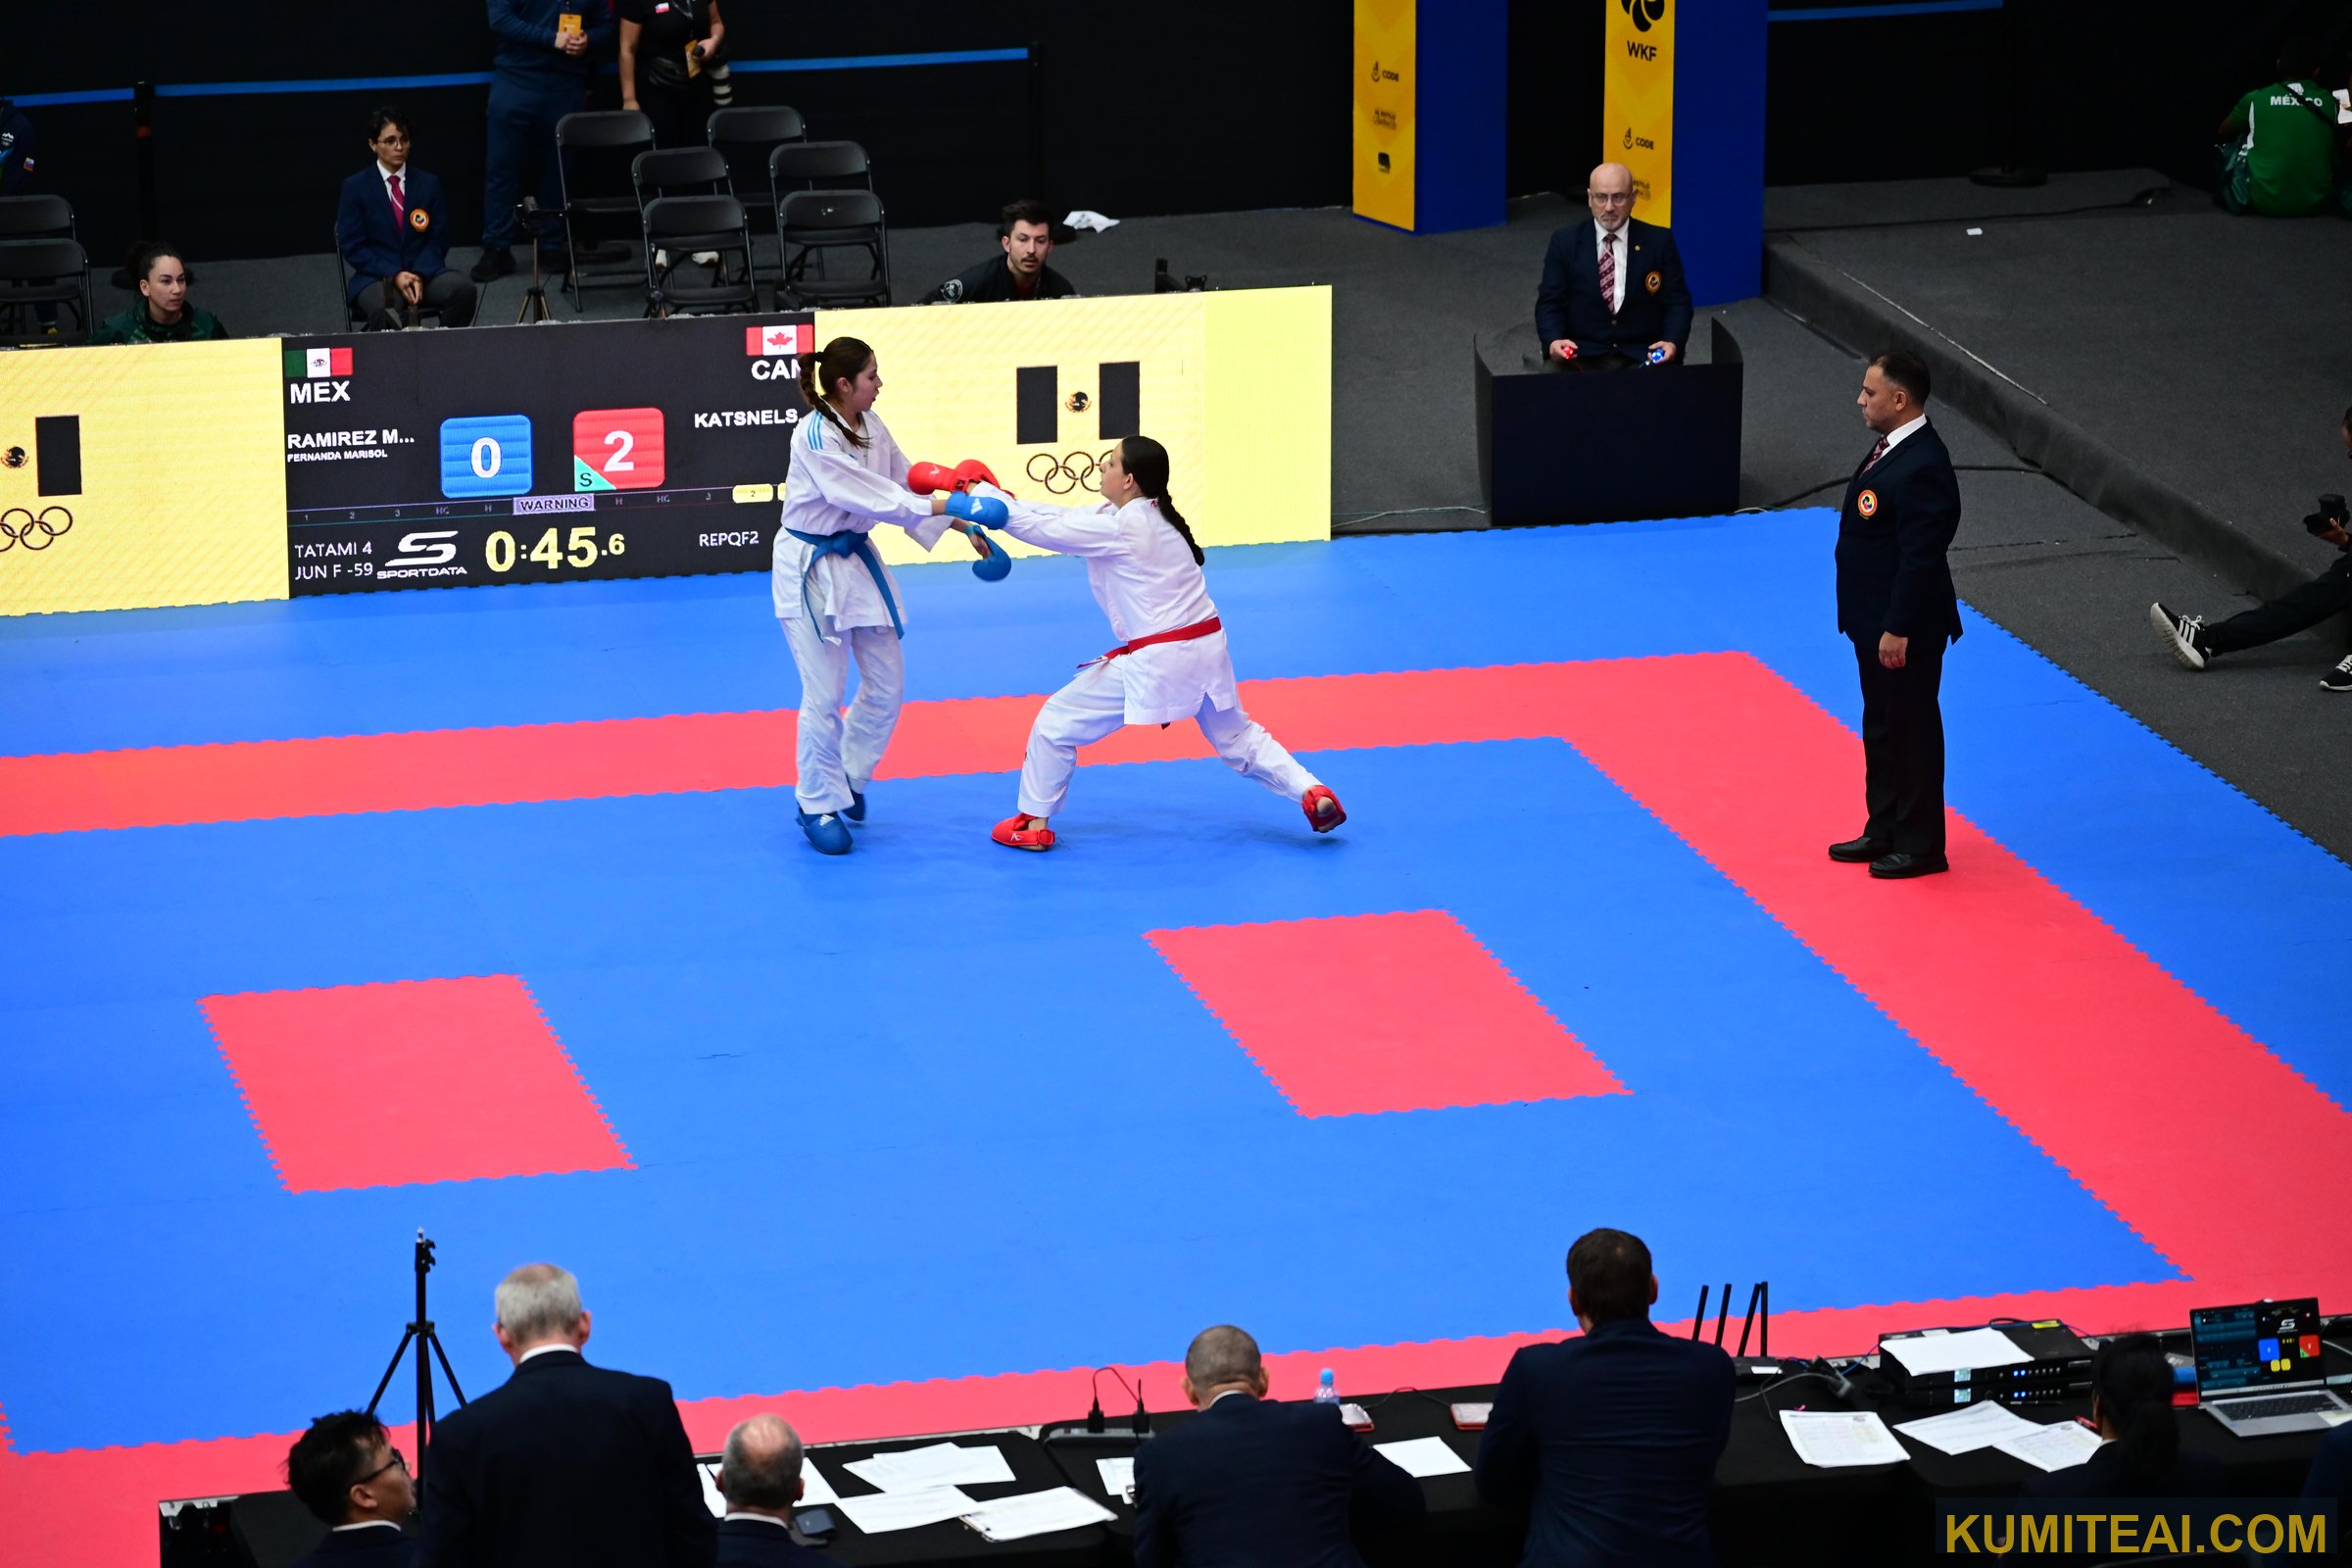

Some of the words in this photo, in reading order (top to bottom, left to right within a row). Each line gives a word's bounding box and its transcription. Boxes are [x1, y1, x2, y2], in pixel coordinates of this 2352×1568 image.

[1626, 39, 1657, 62] WKF
[2270, 93, 2324, 107] MÉXO
[1635, 136, 1655, 150] CODE
[290, 380, 351, 404] MEX
[287, 429, 377, 449] RAMIREZ
[287, 451, 342, 463] FERNANDA
[343, 449, 388, 460] MARISOL
[470, 436, 502, 479] 0
[603, 429, 634, 472] 2
[579, 472, 593, 487] S
[520, 497, 589, 512] WARNING
[699, 530, 760, 548] REPQF2
[294, 541, 358, 559] TATAMI
[362, 540, 372, 555] 4
[294, 564, 327, 580] JUN
[332, 564, 342, 578] F
[347, 563, 373, 577] -59
[376, 565, 468, 580] SPORTDATA
